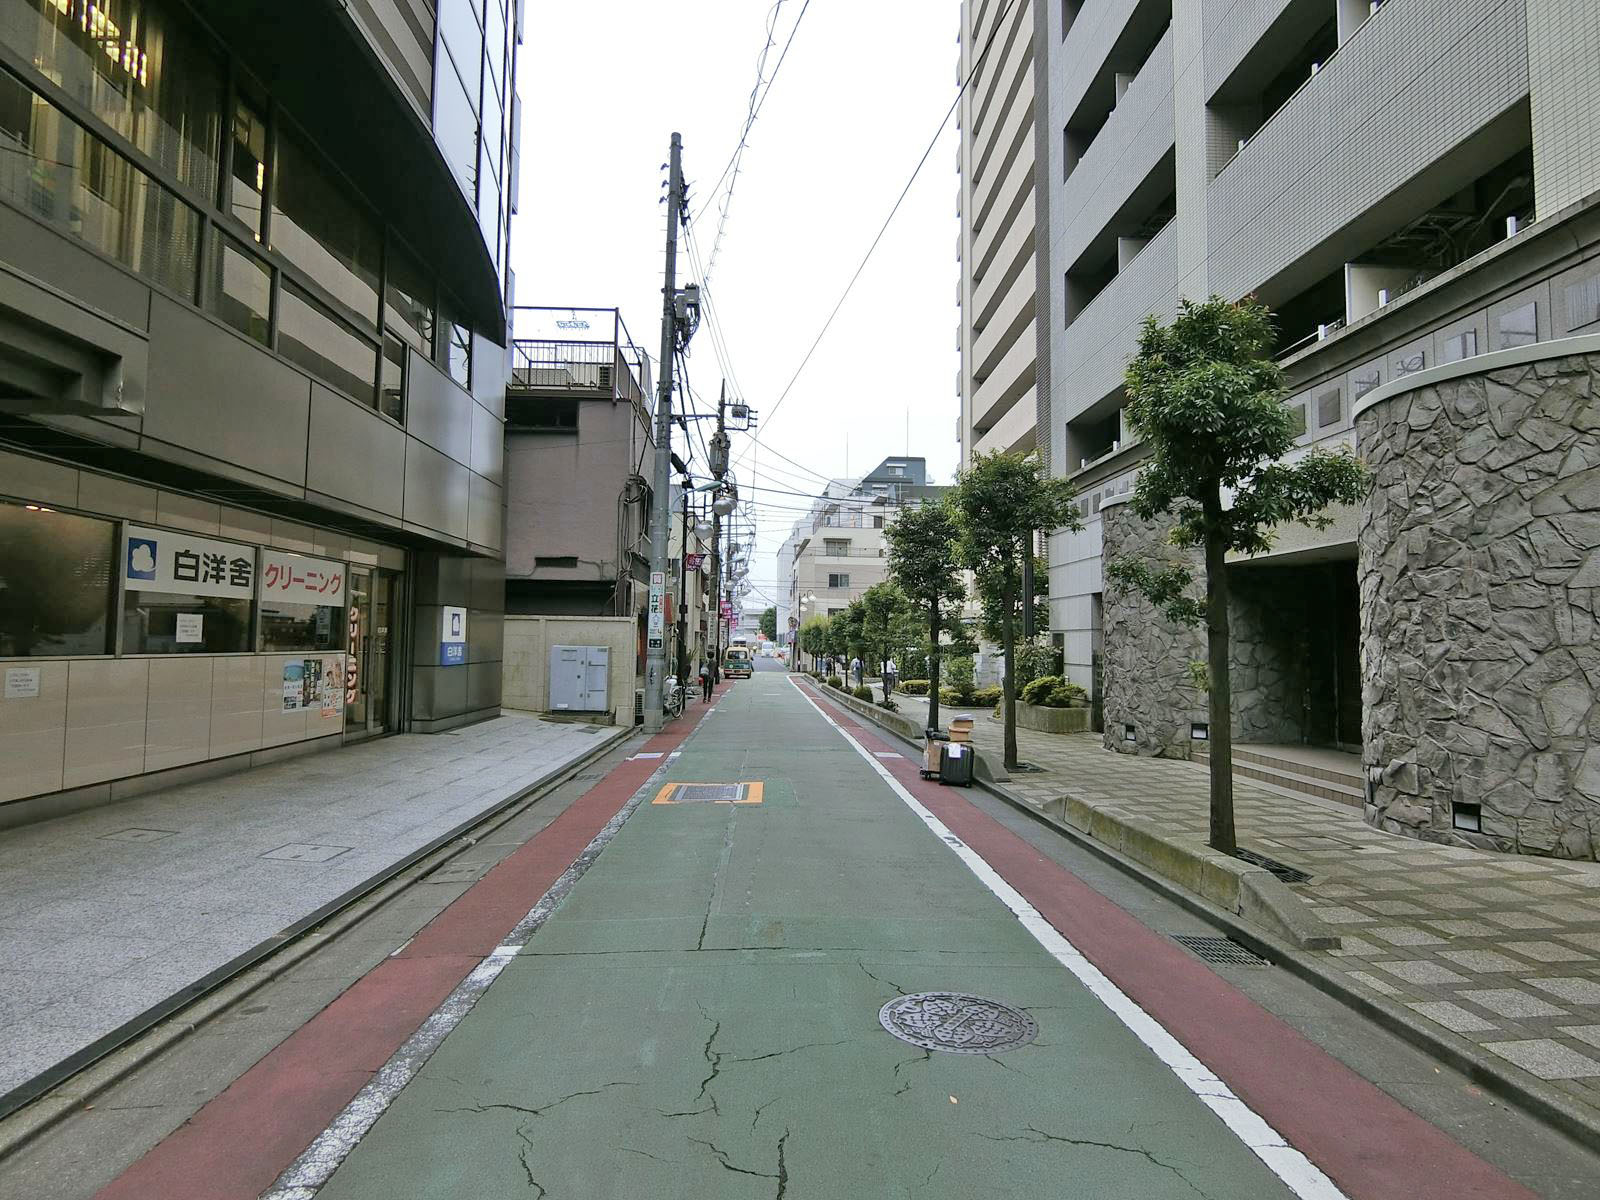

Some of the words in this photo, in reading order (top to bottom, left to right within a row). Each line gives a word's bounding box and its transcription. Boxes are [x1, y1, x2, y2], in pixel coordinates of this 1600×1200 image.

[265, 563, 341, 595] クリーニング
[346, 606, 359, 704] クリーニング
